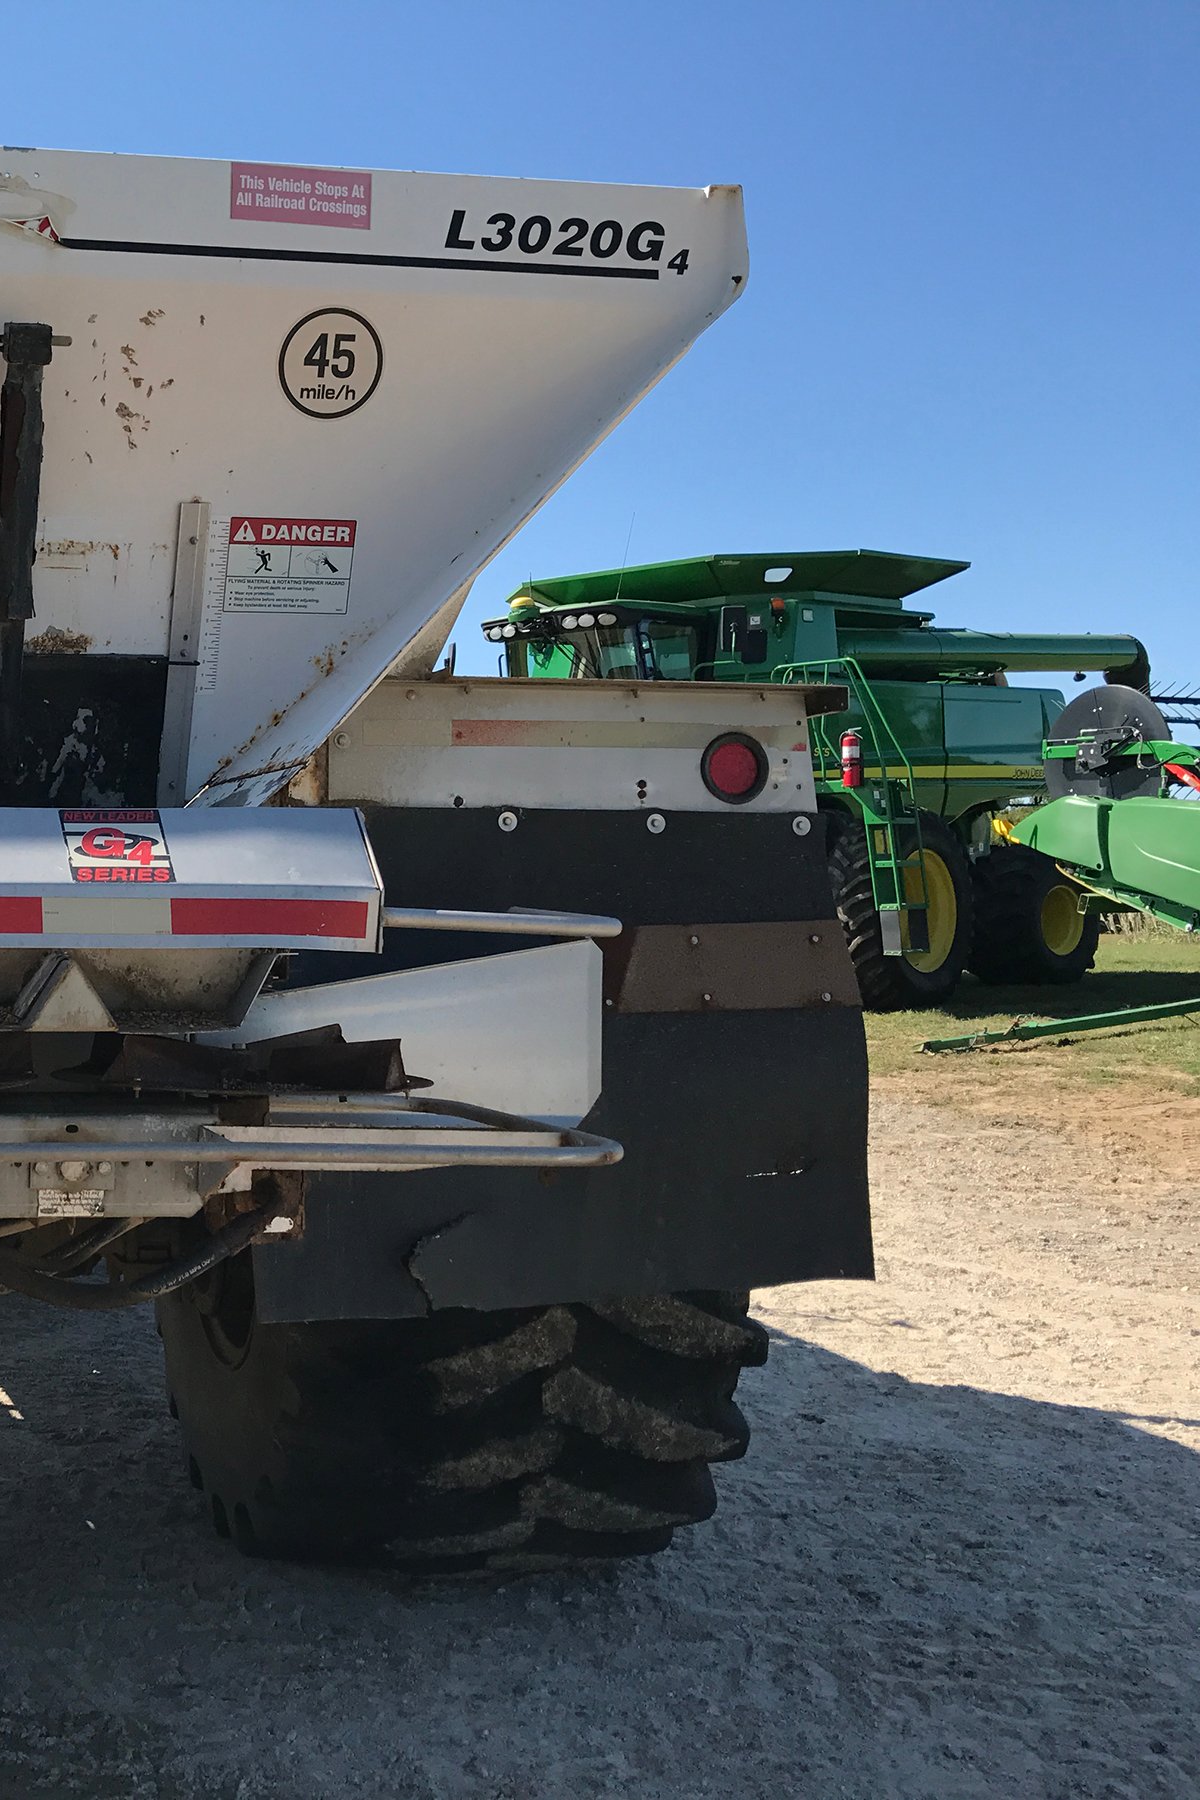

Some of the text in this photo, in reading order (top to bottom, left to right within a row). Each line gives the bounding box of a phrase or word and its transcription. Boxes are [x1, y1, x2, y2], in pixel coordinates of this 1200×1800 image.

[240, 175, 365, 199] This Vehicle Stops At
[236, 192, 367, 218] All Railroad Crossings
[304, 333, 356, 378] 45
[300, 384, 356, 400] mile/h
[261, 524, 350, 542] DANGER
[63, 811, 154, 821] NEW LEADER
[81, 827, 155, 865] G4
[77, 868, 170, 883] SERIES
